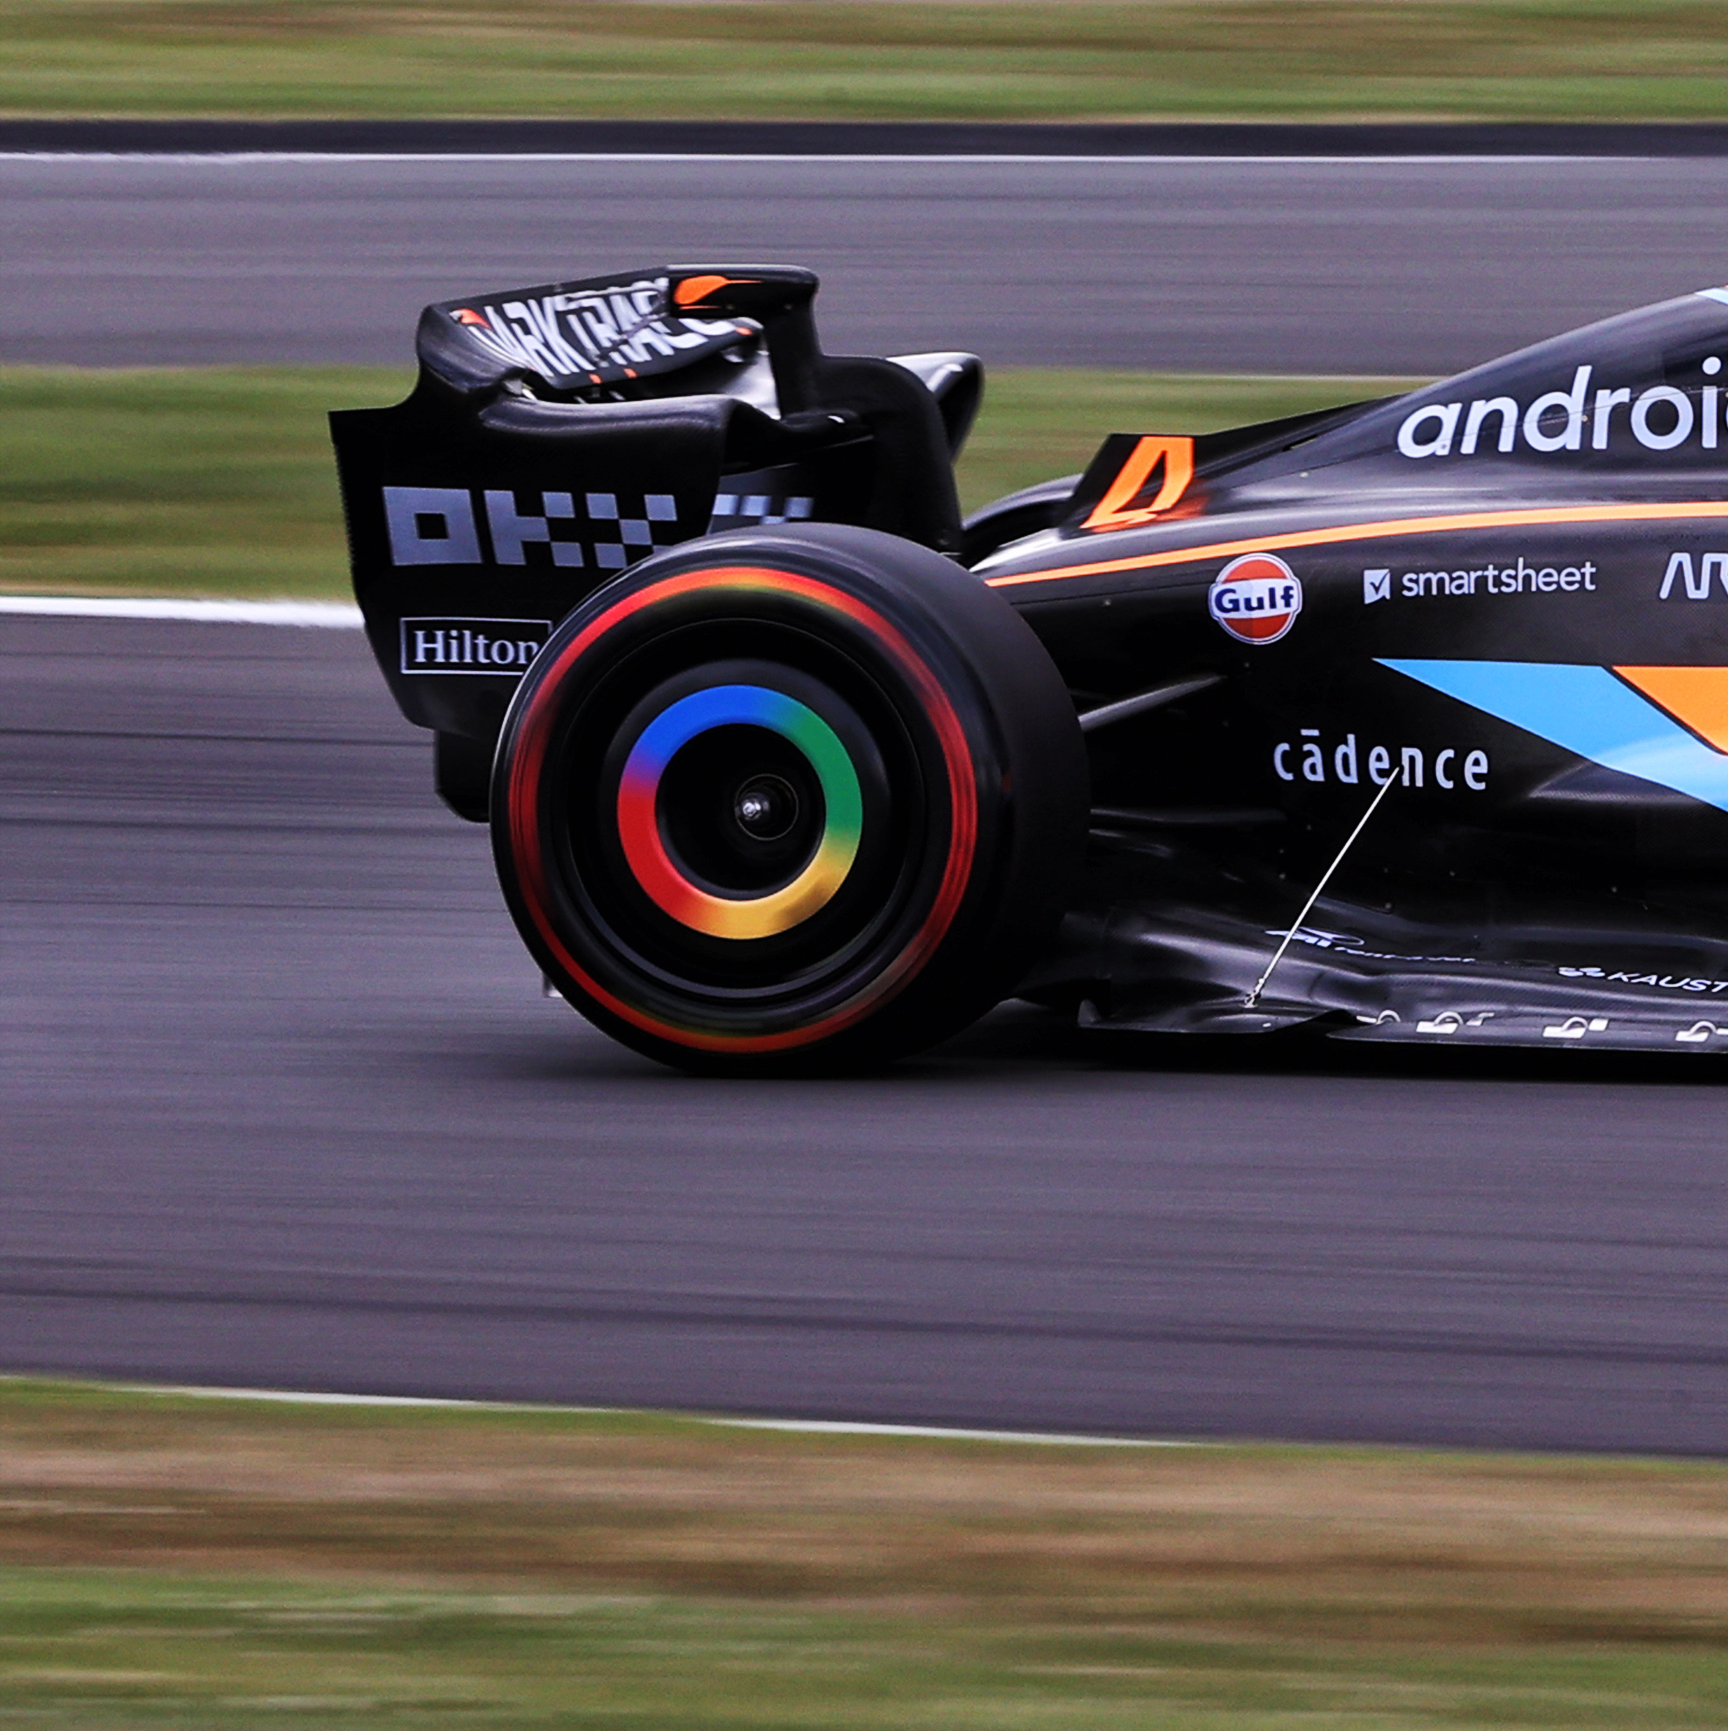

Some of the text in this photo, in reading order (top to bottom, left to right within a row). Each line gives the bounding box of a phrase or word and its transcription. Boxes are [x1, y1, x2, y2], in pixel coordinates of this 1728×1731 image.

[1401, 557, 1597, 597] smartsheet
[1214, 585, 1295, 614] Gulf
[414, 630, 539, 664] Hilton
